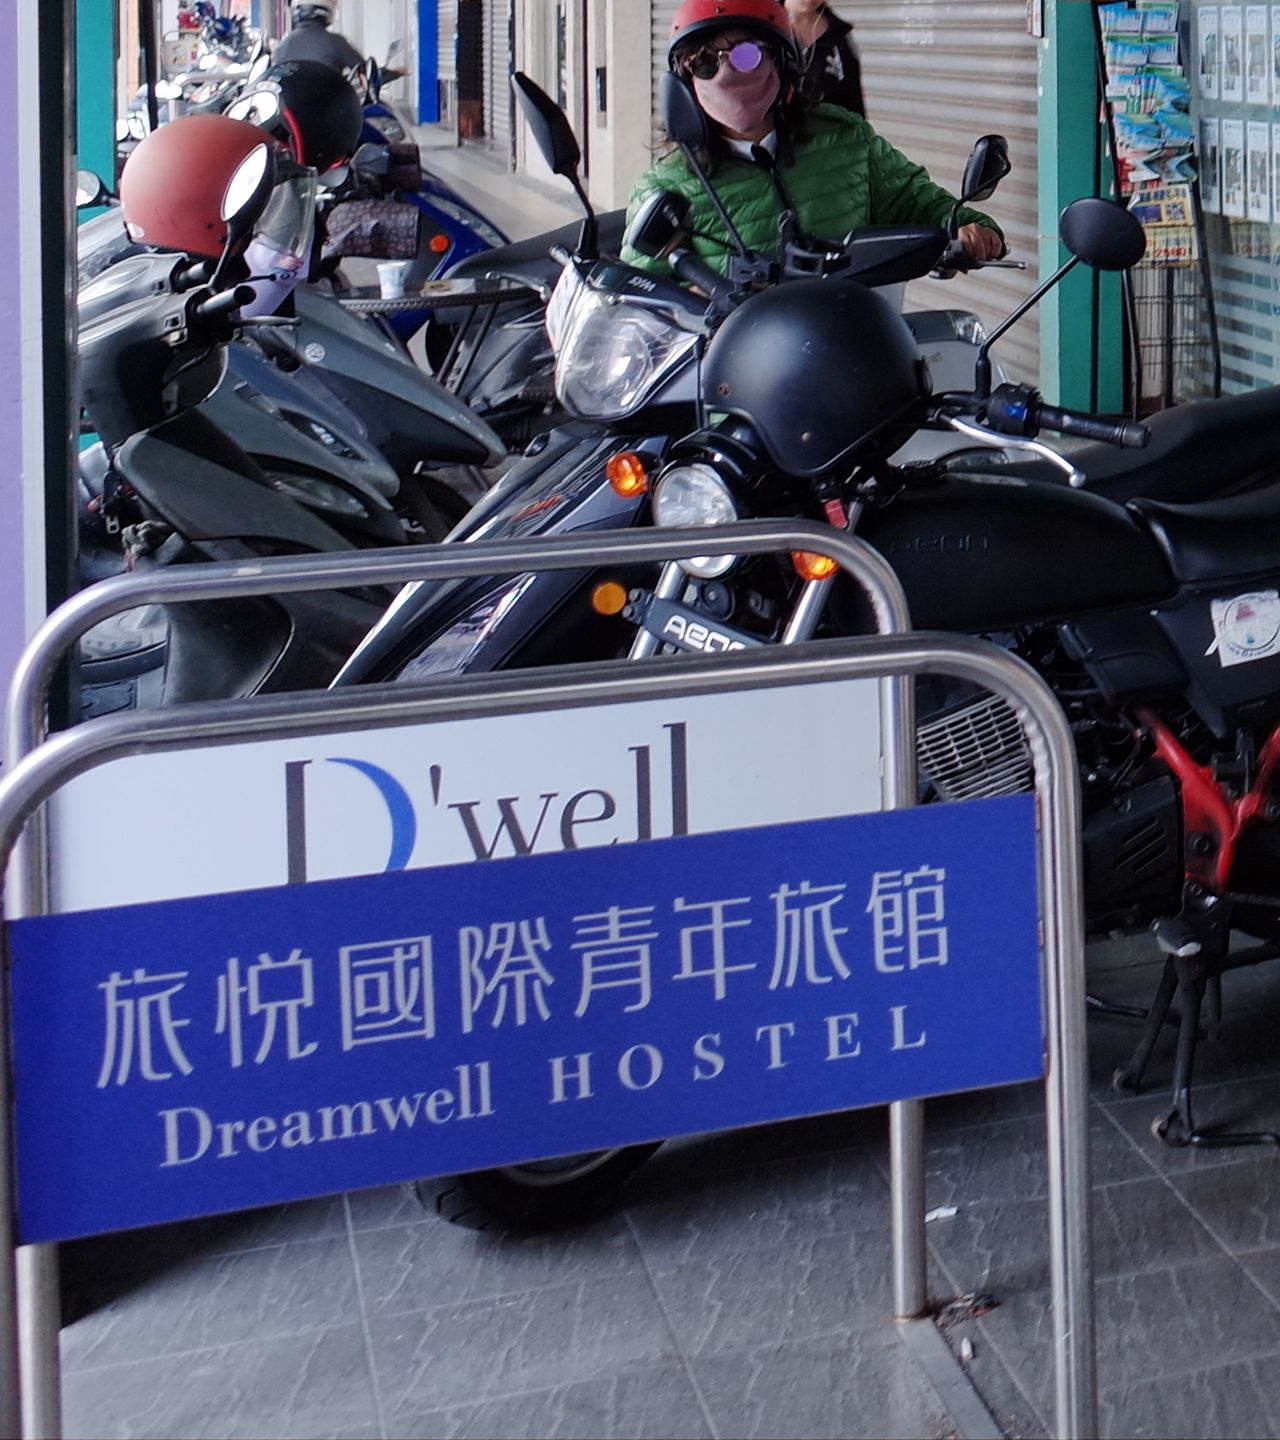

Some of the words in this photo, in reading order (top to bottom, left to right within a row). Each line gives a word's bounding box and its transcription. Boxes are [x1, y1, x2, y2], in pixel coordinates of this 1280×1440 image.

[284, 721, 690, 886] D'well
[96, 864, 949, 1090] 旅悅國際青年旅館
[158, 1061, 497, 1169] Dreamwell
[548, 1004, 929, 1106] HOSTEL
